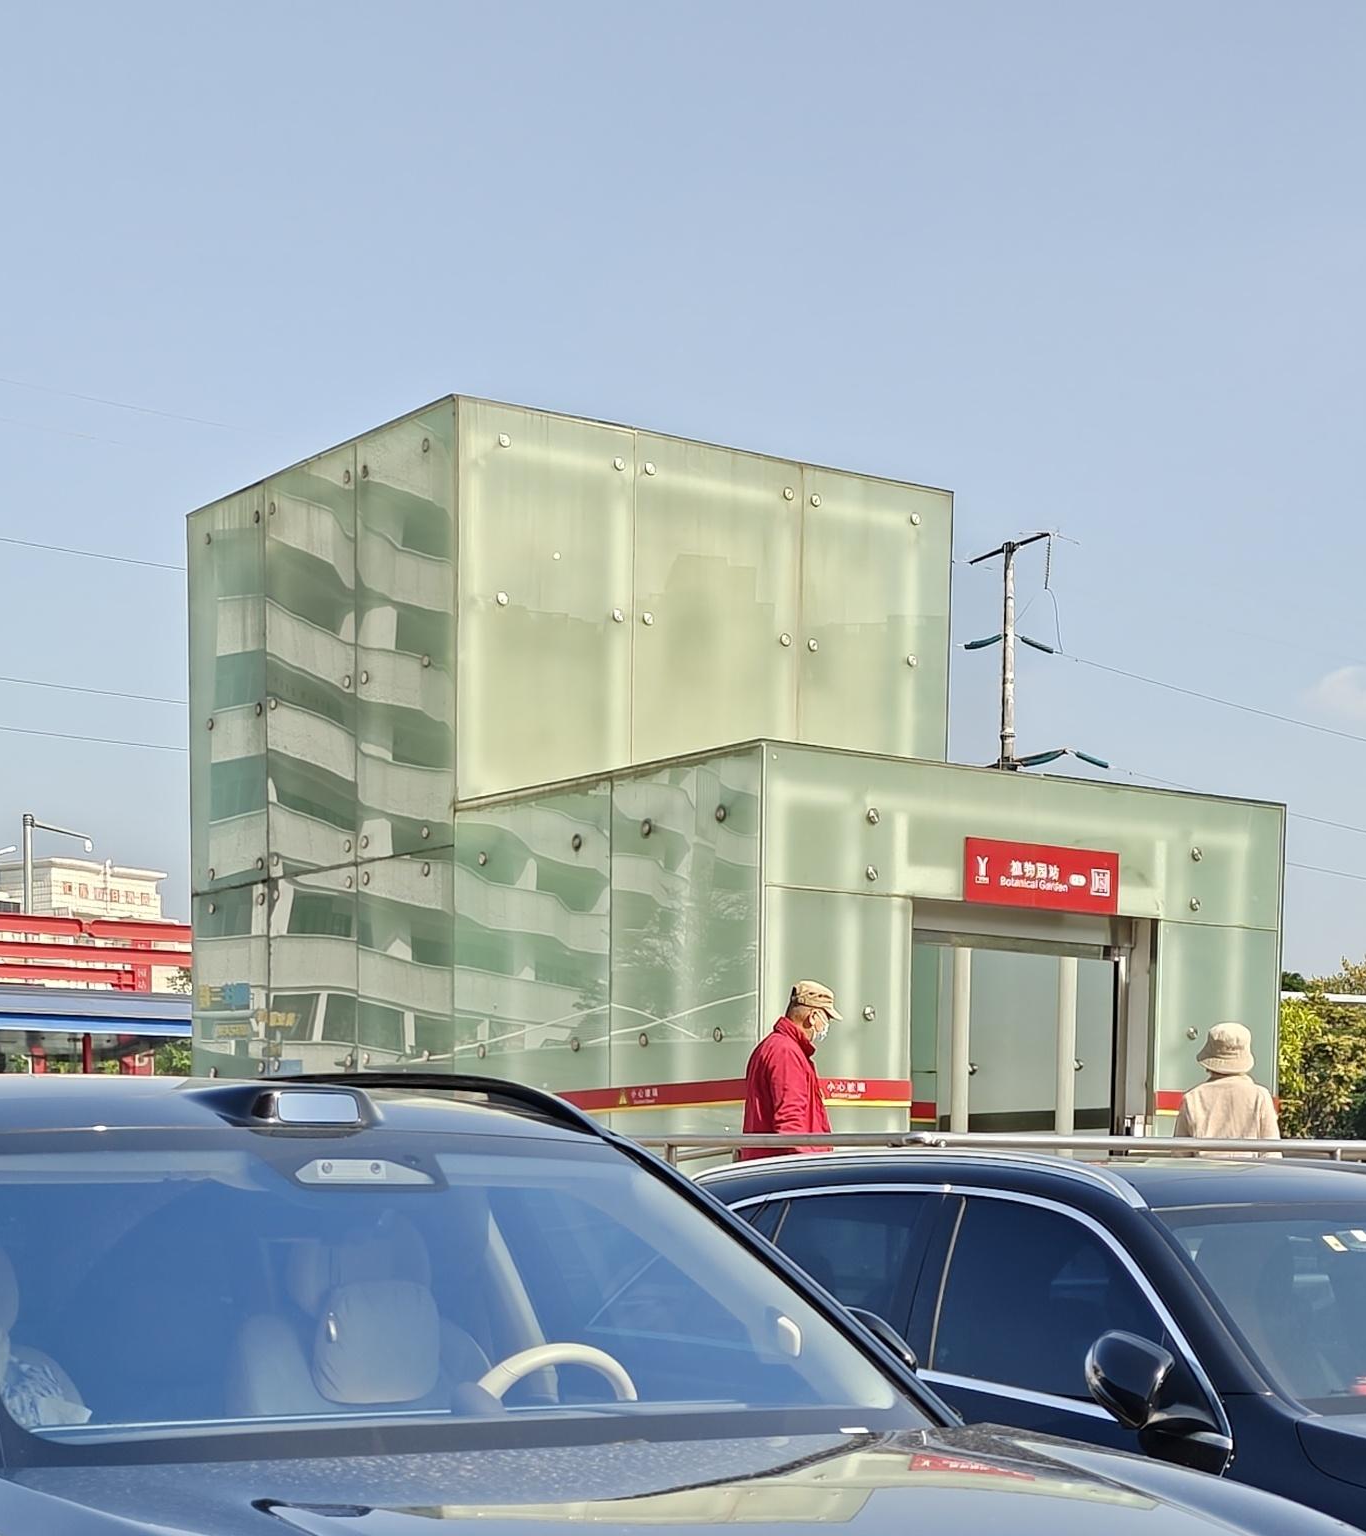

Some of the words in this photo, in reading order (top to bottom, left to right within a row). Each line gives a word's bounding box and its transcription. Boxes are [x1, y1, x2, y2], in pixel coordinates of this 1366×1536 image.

[1010, 860, 1059, 880] 植物园站
[1000, 876, 1039, 889] Botanical
[1039, 881, 1068, 892] Garden
